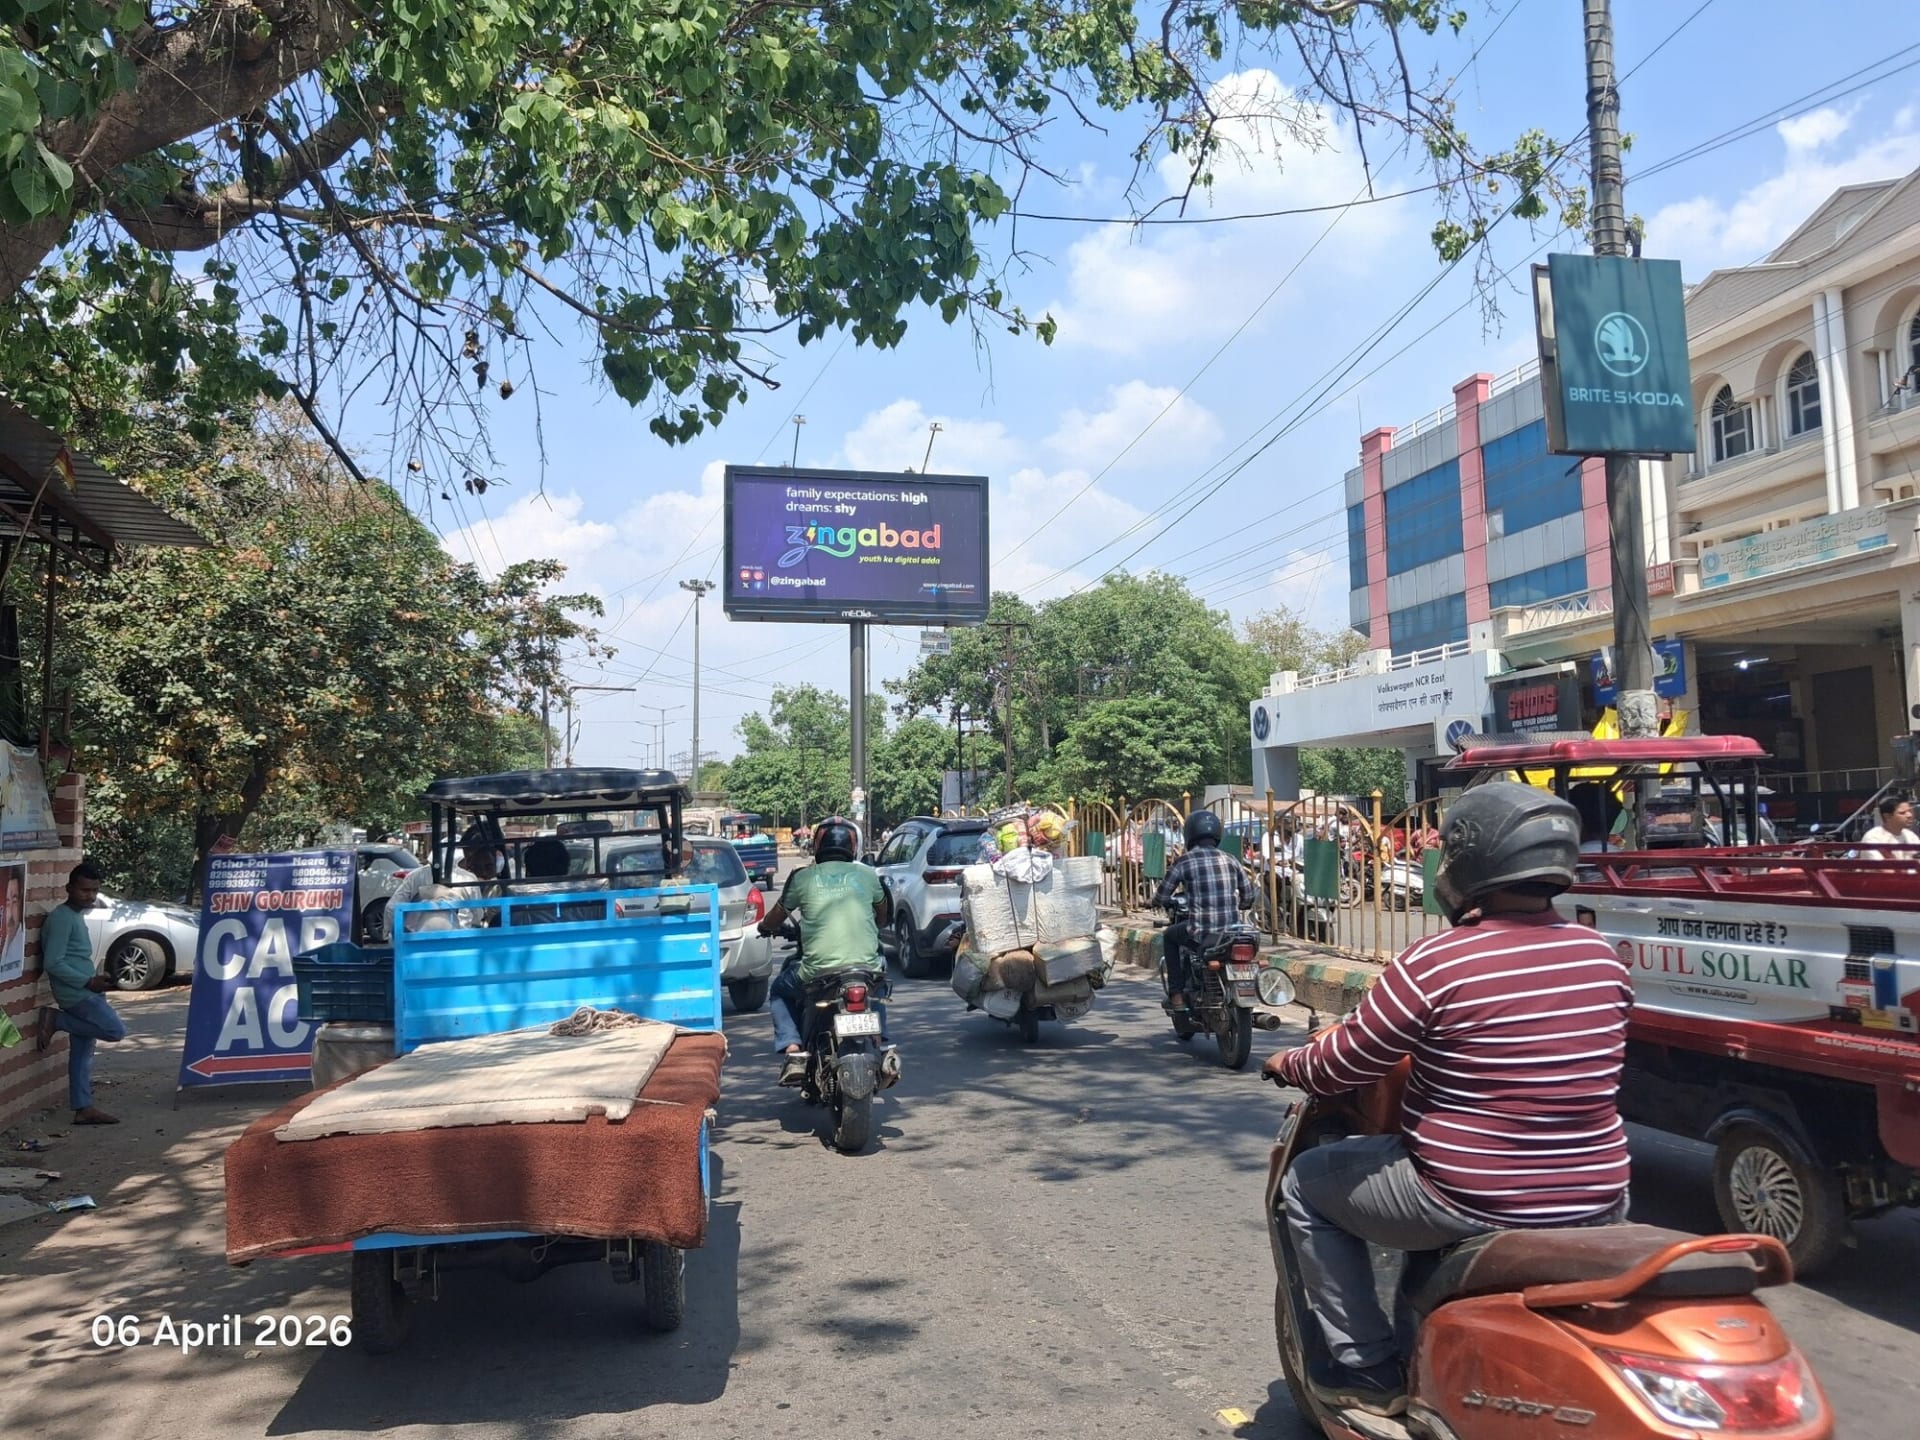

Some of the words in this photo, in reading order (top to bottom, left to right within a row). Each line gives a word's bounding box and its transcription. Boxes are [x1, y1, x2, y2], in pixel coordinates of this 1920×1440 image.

[1569, 387, 1611, 403] BRITE
[786, 487, 822, 501] family
[824, 489, 899, 502] expectations:
[901, 491, 928, 505] high
[786, 501, 832, 513] dreams:
[834, 503, 857, 516] shy
[777, 519, 942, 568] zingabad
[859, 555, 882, 564] youth
[883, 555, 893, 564] ka
[894, 556, 920, 566] digital
[921, 556, 941, 565] adda
[770, 576, 826, 588] @zingabad
[1377, 681, 1414, 693] Volkswagen
[1415, 675, 1429, 687] NCR
[1431, 673, 1445, 684] East
[1508, 684, 1559, 719] STUDDS
[211, 859, 243, 869] Ashu
[248, 858, 268, 868] Pal
[293, 857, 329, 867] Neeraj
[332, 856, 350, 865] Pal
[210, 891, 253, 913] SHIV
[256, 889, 343, 912] GOURUKH
[1657, 917, 1680, 936] आप
[1681, 919, 1702, 938] कब
[1704, 920, 1741, 941] लगवा
[1742, 919, 1762, 943] रहे
[1638, 943, 1694, 975] UTL
[1702, 950, 1811, 990] SOLAR
[214, 984, 311, 1051] AC
